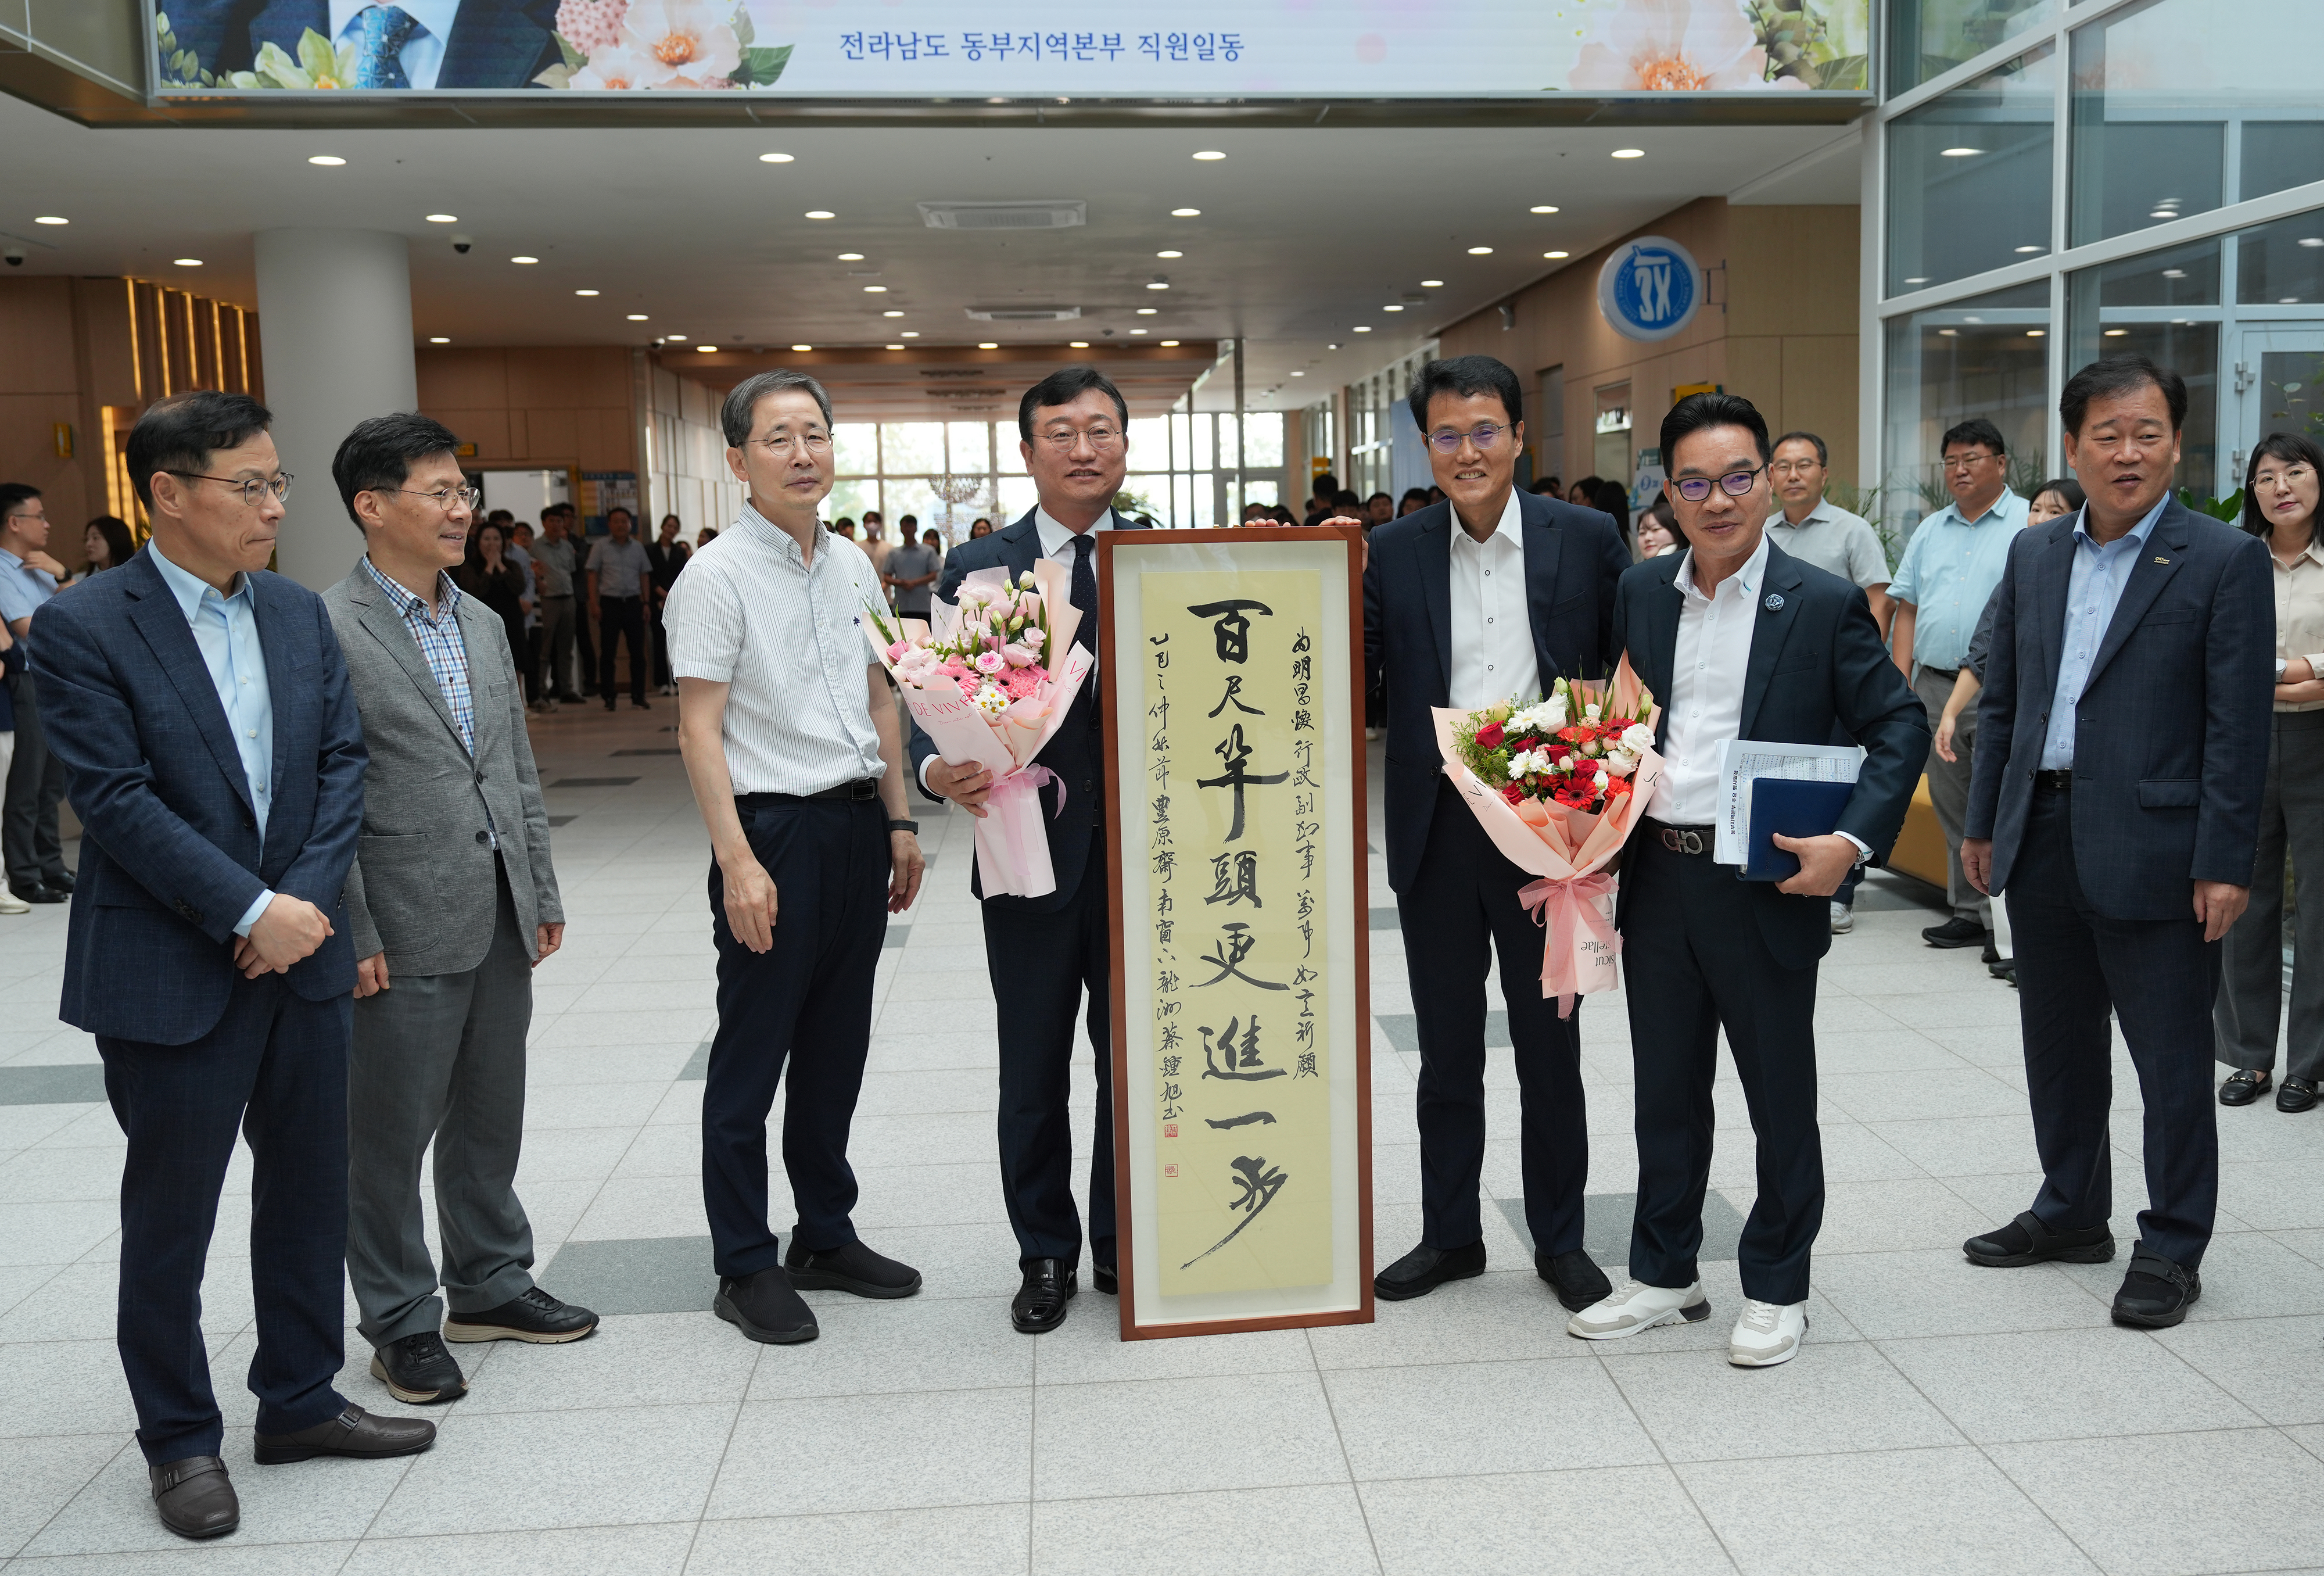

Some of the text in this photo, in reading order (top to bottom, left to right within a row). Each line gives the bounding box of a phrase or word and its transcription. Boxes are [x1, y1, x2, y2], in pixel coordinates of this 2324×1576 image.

[840, 31, 1245, 62] 전라남도 동부지역본부 직원일동
[1731, 793, 1737, 803] 주요
[1595, 955, 1614, 966] sicut
